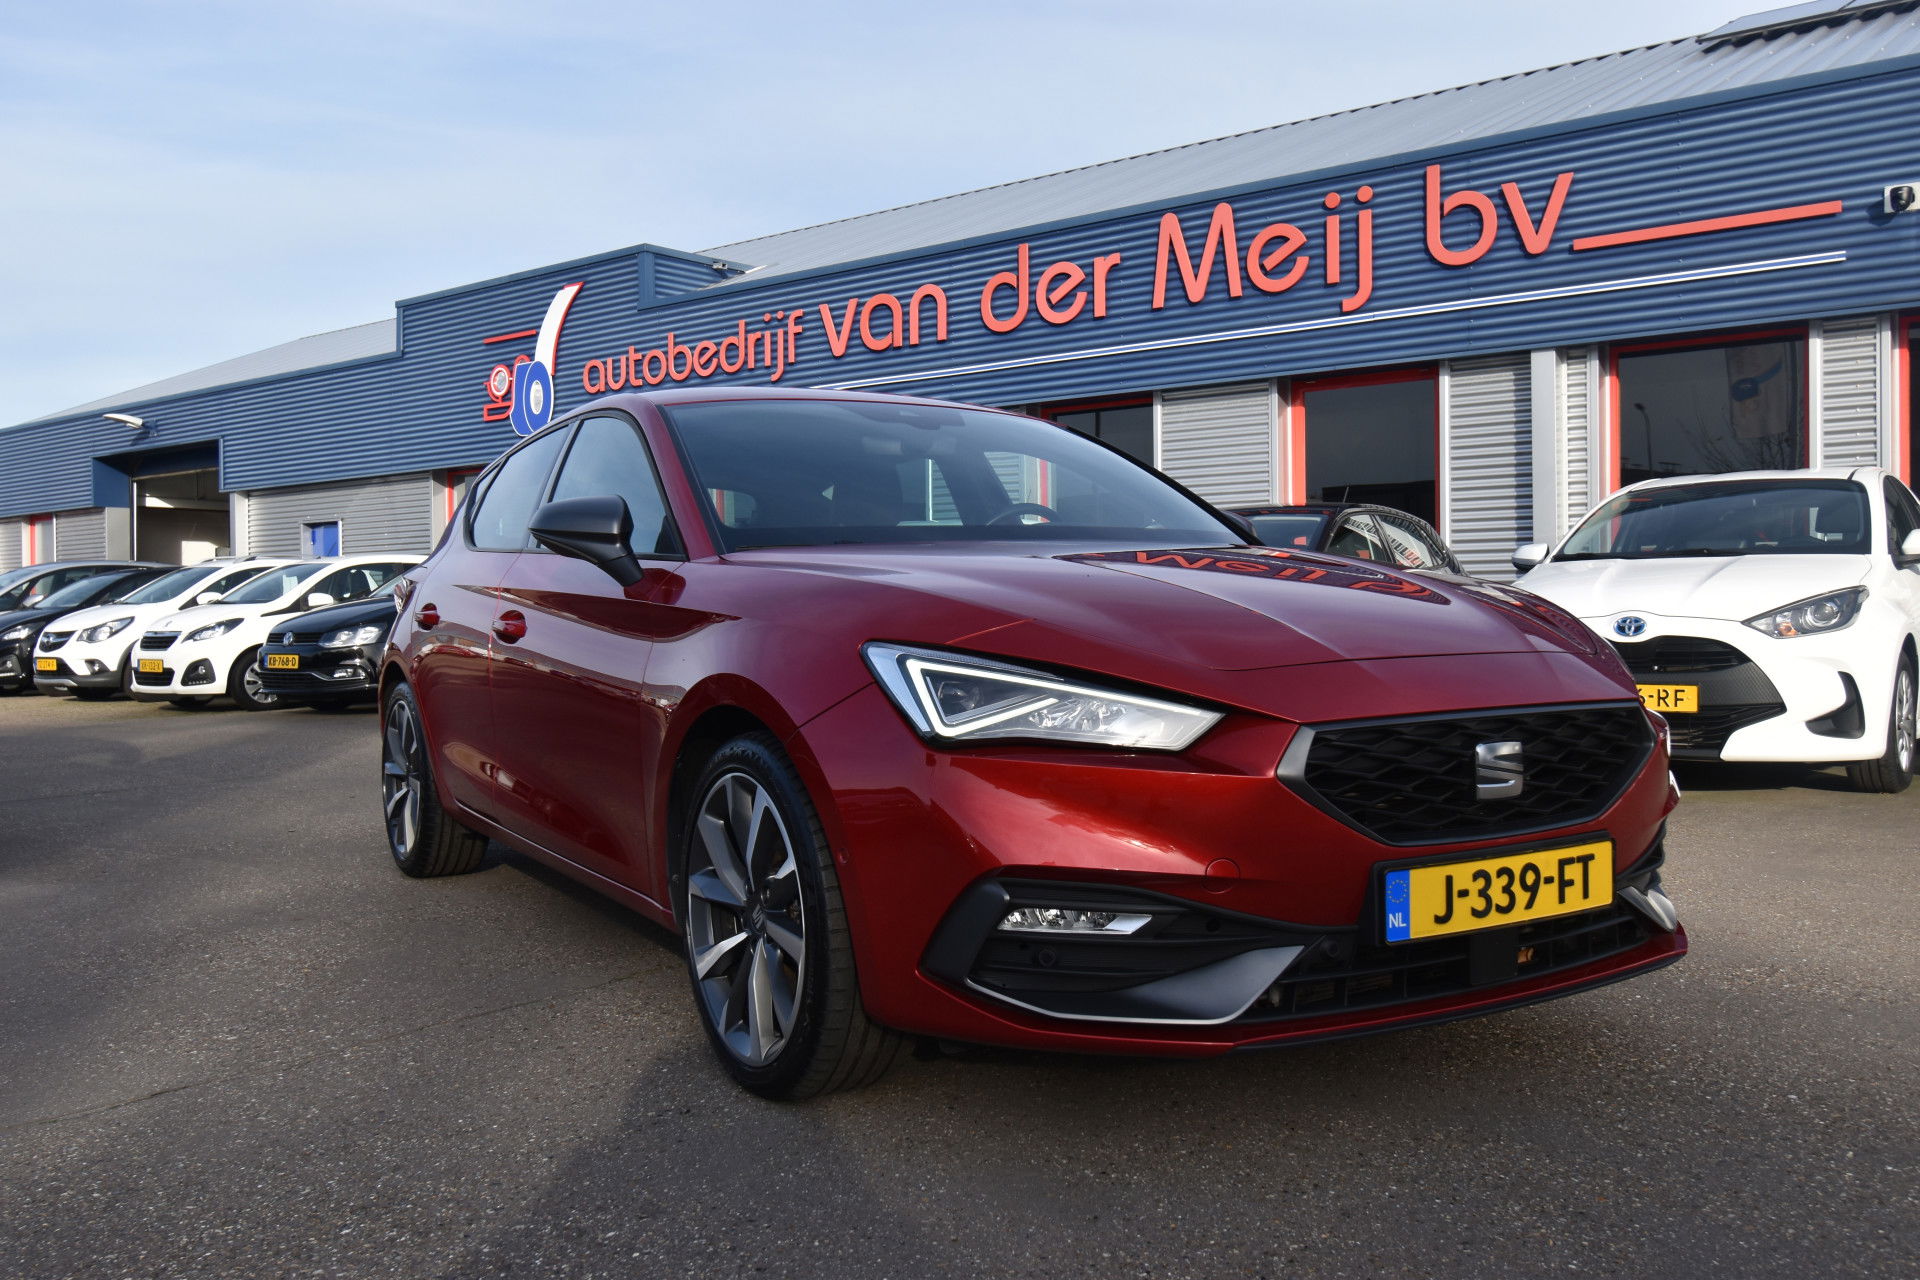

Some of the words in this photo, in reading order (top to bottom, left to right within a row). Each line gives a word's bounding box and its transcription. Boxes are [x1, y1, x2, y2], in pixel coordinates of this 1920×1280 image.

[583, 309, 804, 394] autobedrijf
[819, 284, 948, 357] van
[980, 243, 1122, 334] der
[1152, 185, 1374, 314] Meij
[1426, 164, 1574, 266] bv
[1388, 912, 1407, 929] NL
[1433, 853, 1595, 925] J-339-FT
